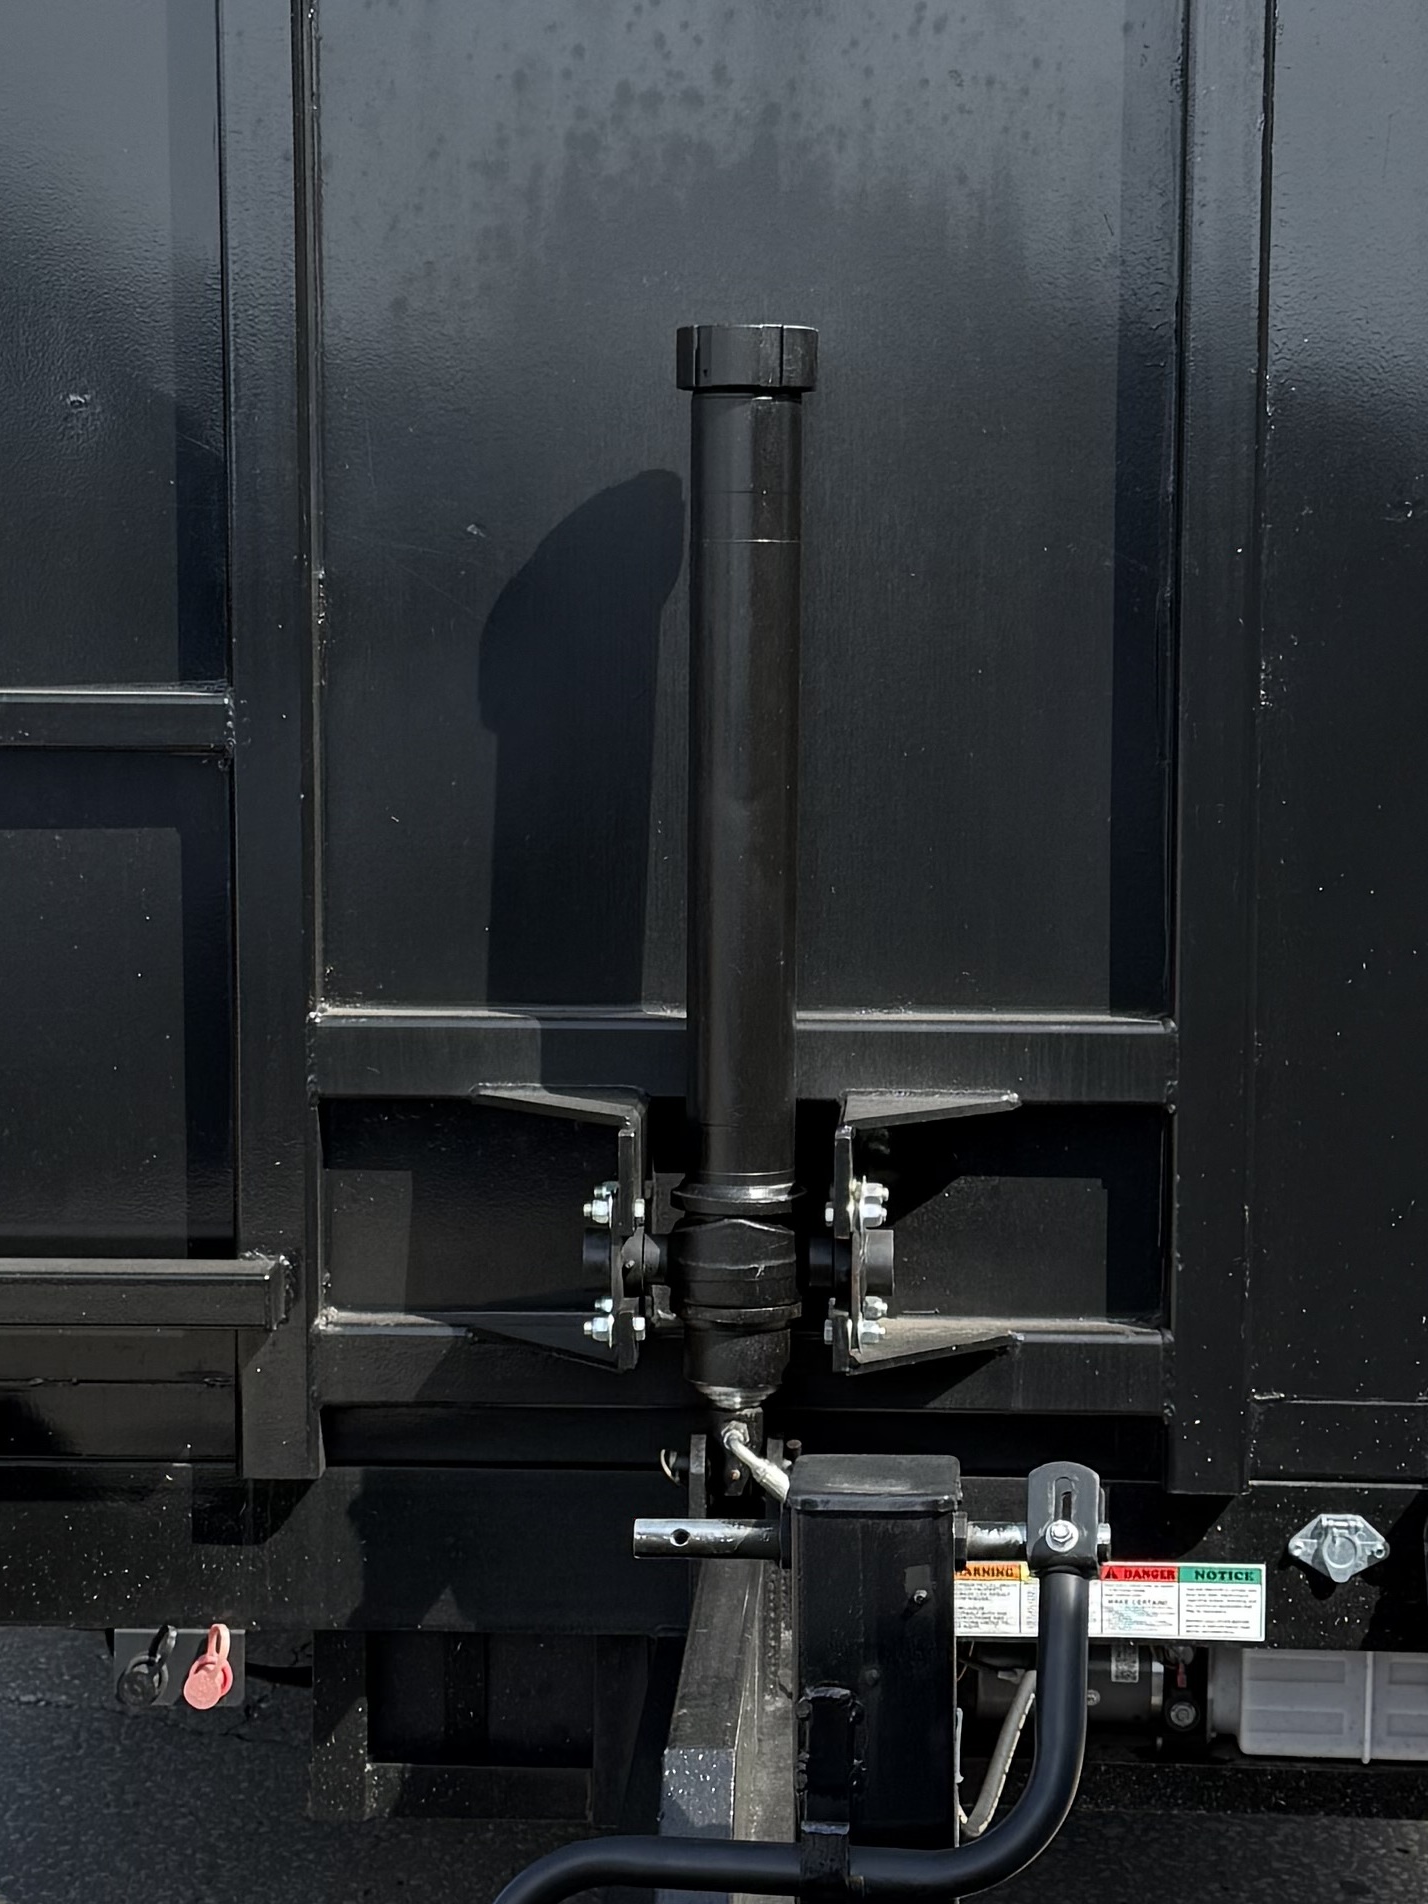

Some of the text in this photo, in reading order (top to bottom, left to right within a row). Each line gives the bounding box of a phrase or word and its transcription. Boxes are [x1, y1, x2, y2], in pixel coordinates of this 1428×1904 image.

[958, 1566, 1014, 1578] ARNING
[1123, 1569, 1176, 1580] DANGER
[1194, 1570, 1255, 1582] NOTICE
